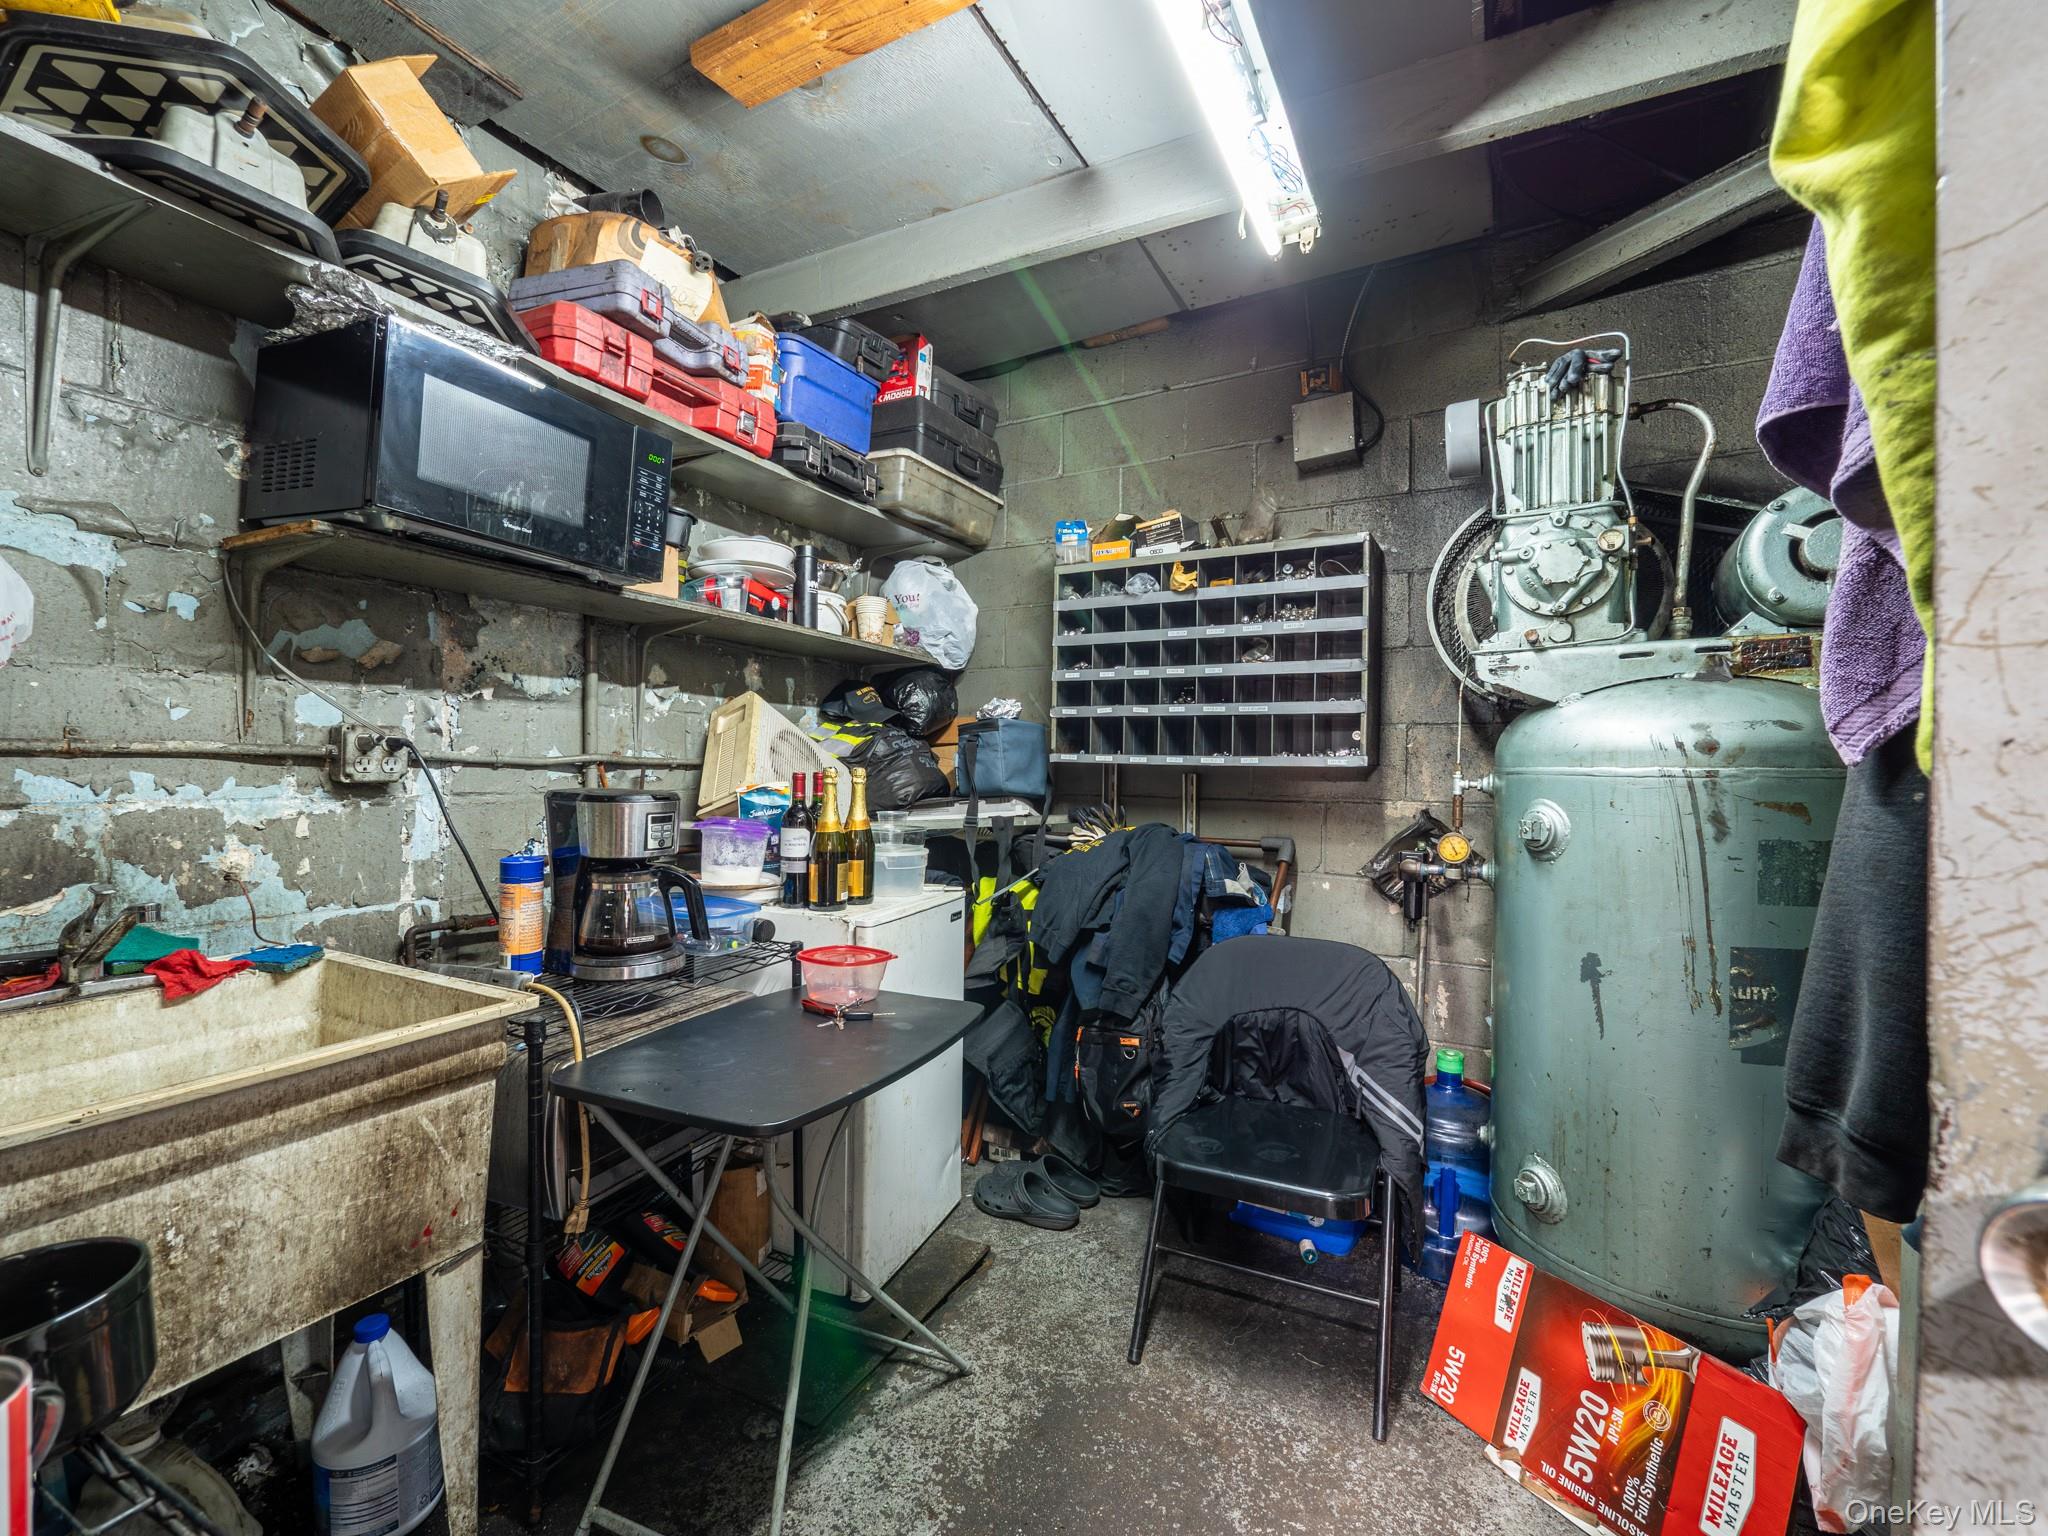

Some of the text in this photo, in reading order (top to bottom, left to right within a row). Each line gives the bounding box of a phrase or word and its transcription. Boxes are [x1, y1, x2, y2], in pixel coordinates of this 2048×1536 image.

[883, 387, 913, 402] ARROW
[894, 593, 920, 605] You!
[1464, 1237, 1484, 1289] Full Synthetic
[1478, 1243, 1491, 1264] 100%
[1437, 1345, 1466, 1405] 5W20
[1507, 1378, 1530, 1441] MILEAGE
[1519, 1390, 1537, 1442] MASTER
[1606, 1406, 1625, 1446] API:SN
[1563, 1390, 1609, 1484] 5W20
[1621, 1475, 1640, 1513] 100%
[1640, 1437, 1664, 1499] Synthetic
[1704, 1432, 1738, 1529] MILEAGE
[1724, 1451, 1750, 1530] MASTER
[1540, 1460, 1650, 1536] ASOLINE ENGINE OIL
[1634, 1496, 1651, 1525] Full
